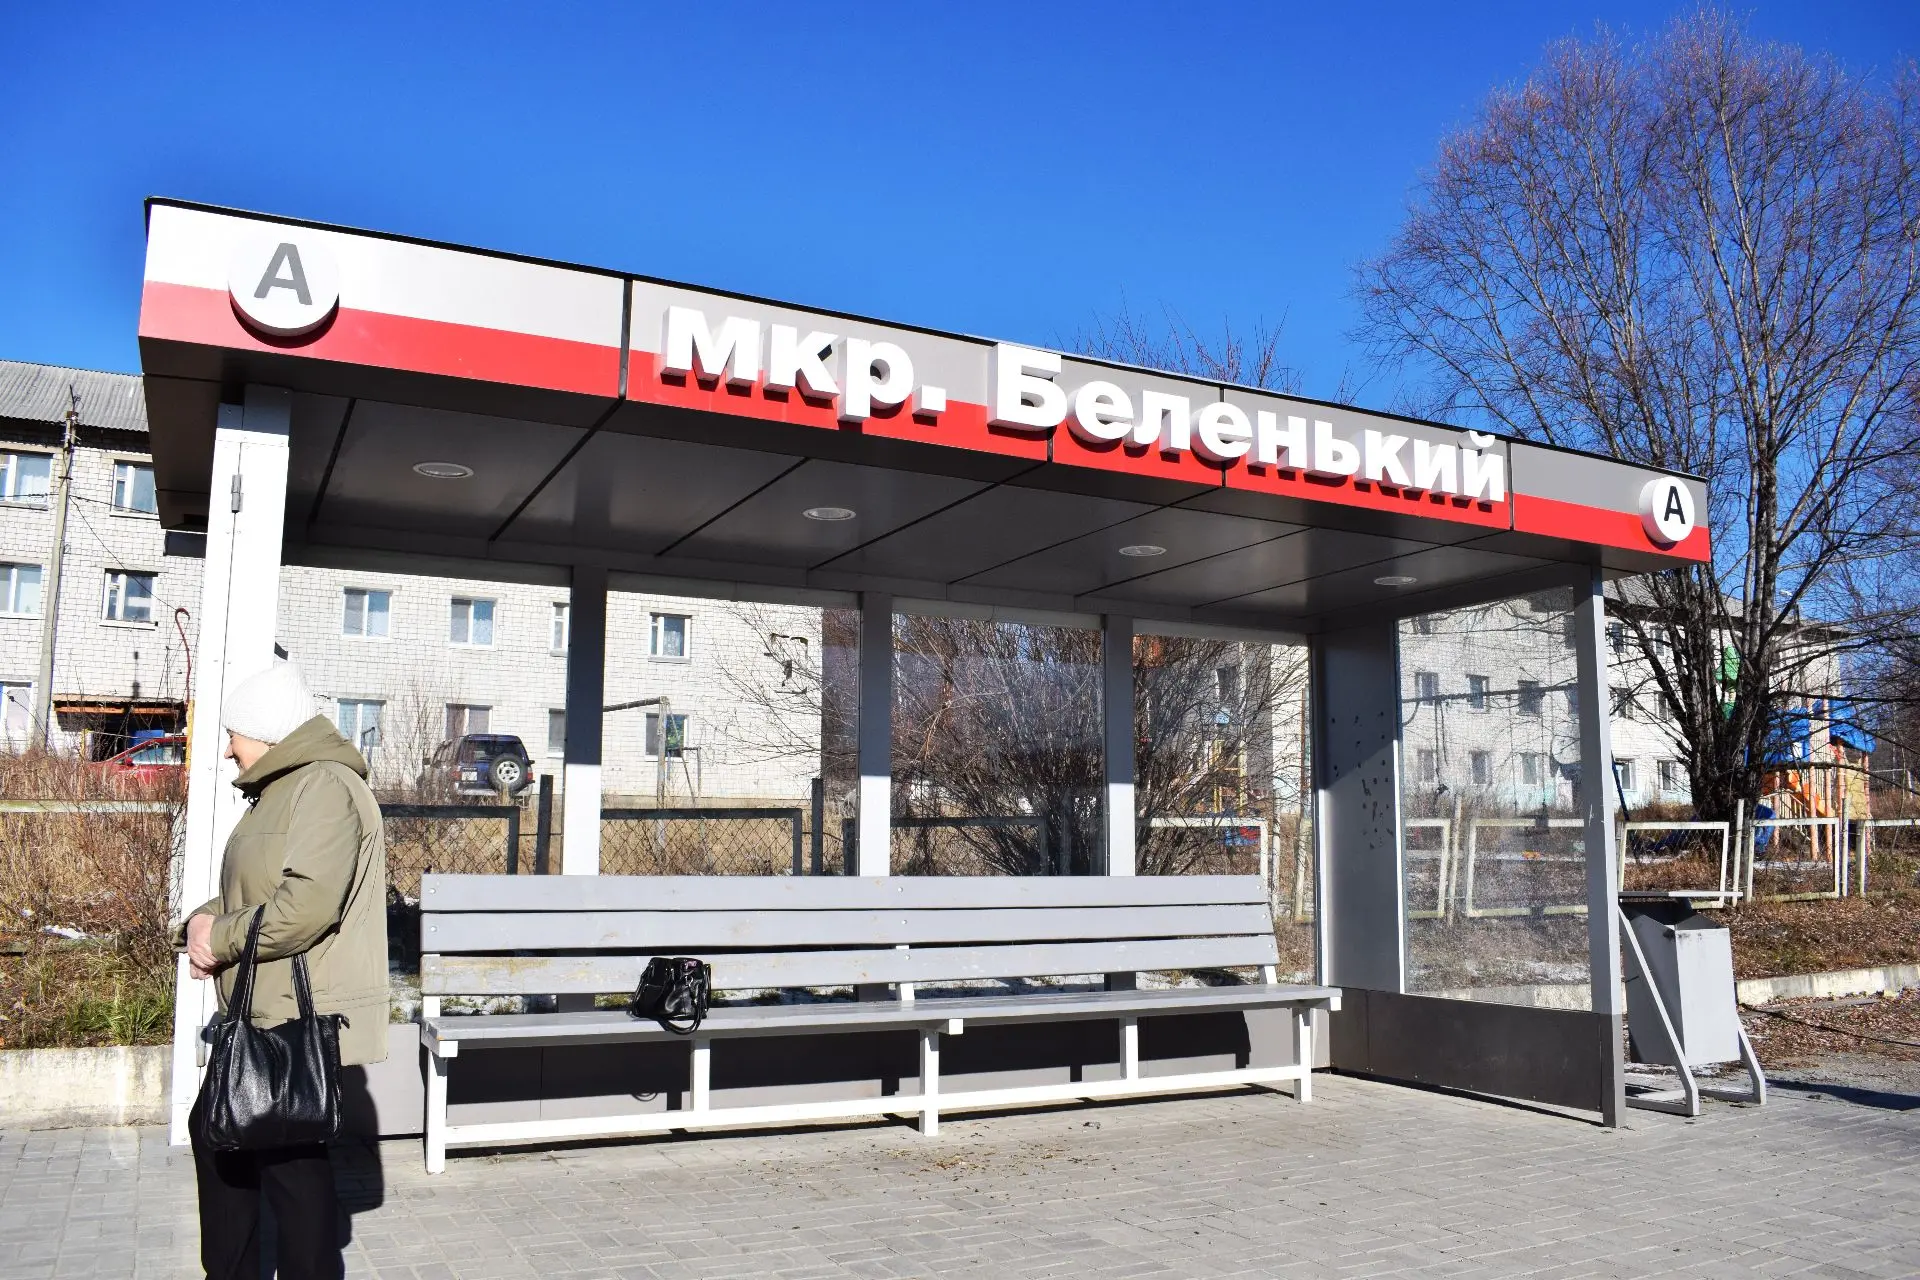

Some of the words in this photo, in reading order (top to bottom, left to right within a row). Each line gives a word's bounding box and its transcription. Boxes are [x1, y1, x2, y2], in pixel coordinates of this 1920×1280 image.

[254, 242, 313, 305] А
[988, 342, 1505, 503] Беленький
[1663, 485, 1686, 525] А
